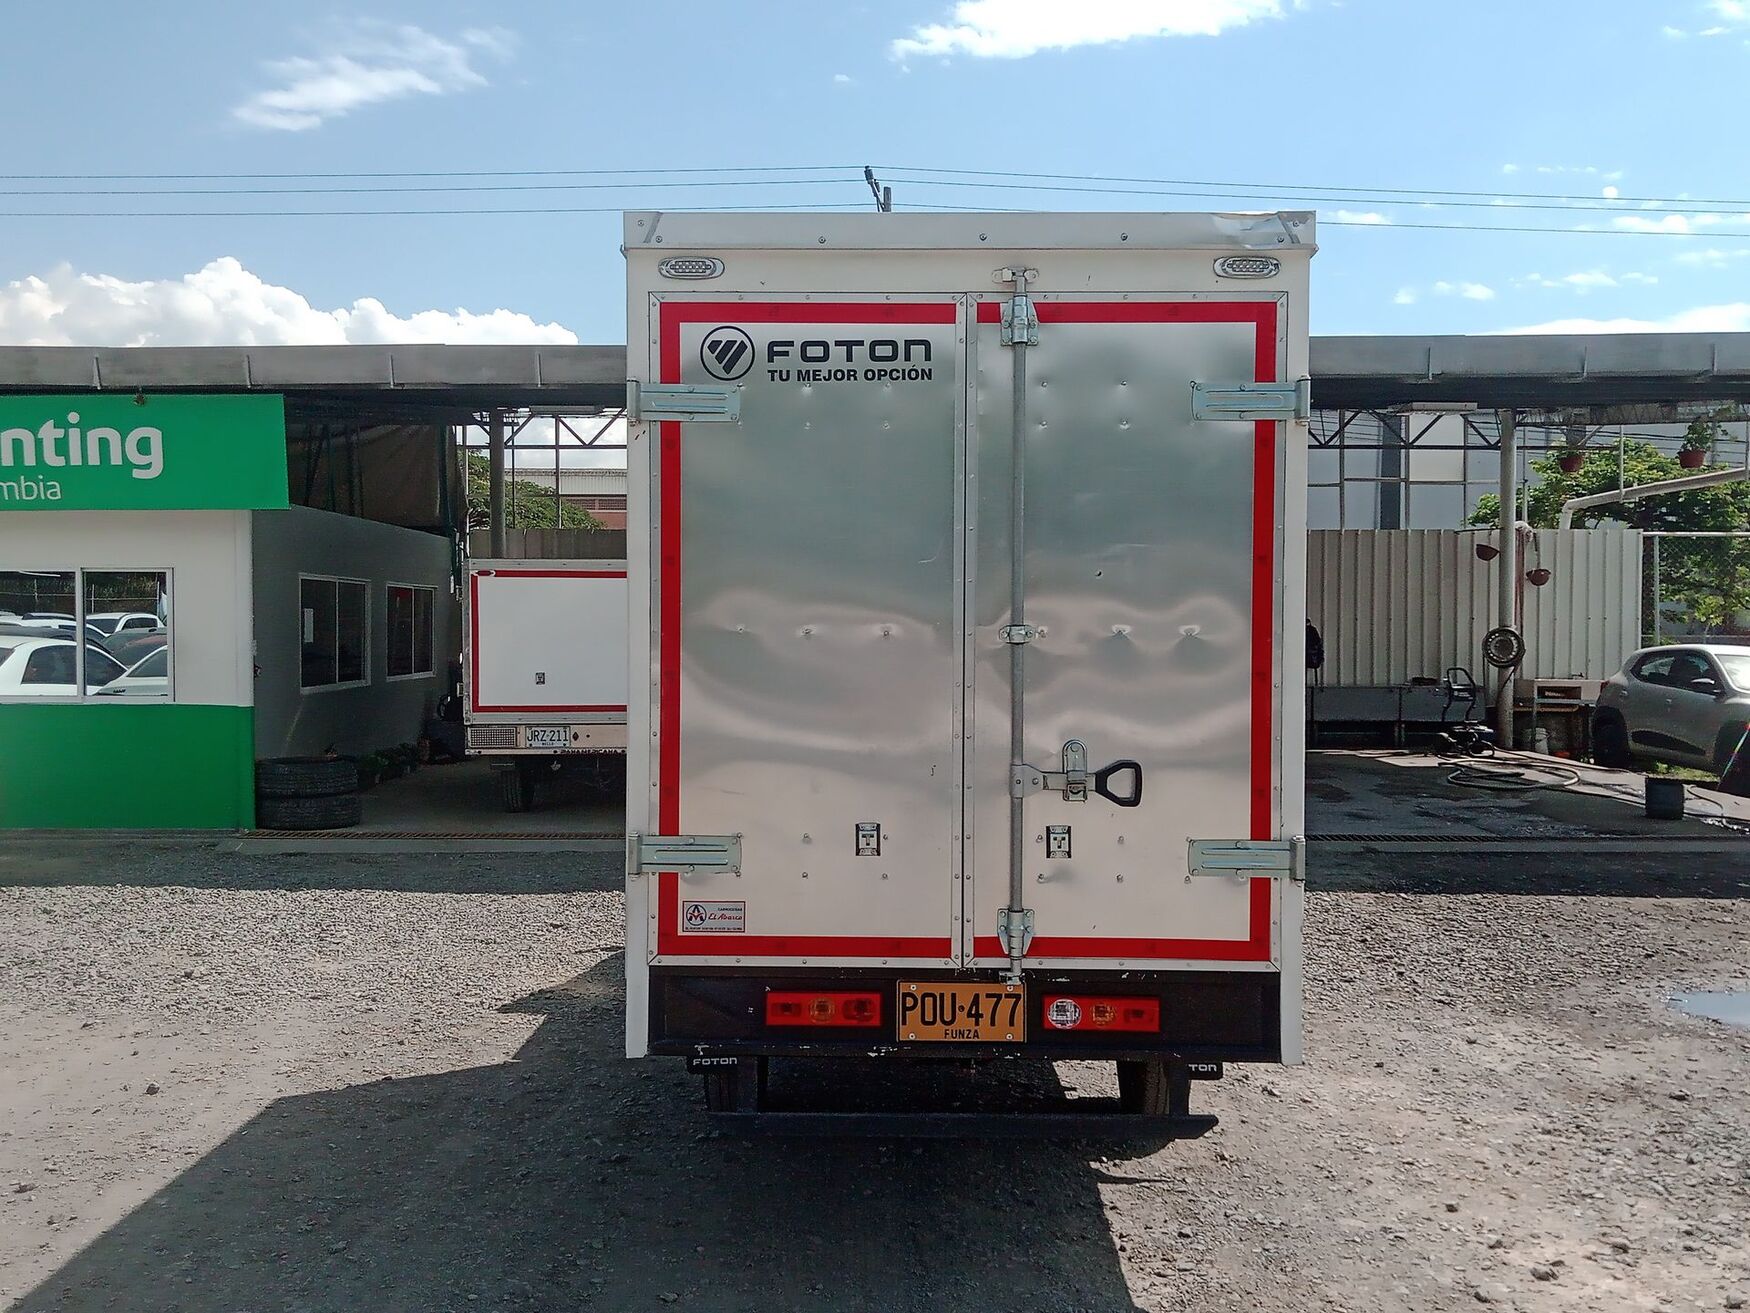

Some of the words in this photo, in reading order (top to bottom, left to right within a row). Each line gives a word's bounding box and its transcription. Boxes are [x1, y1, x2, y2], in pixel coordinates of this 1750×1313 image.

[767, 339, 932, 363] FOTON
[768, 369, 790, 382] TU
[797, 368, 858, 381] MEJOR
[863, 364, 932, 381] OPCIÓN
[944, 1029, 979, 1039] FUNZA
[692, 1057, 738, 1066] FOTON
